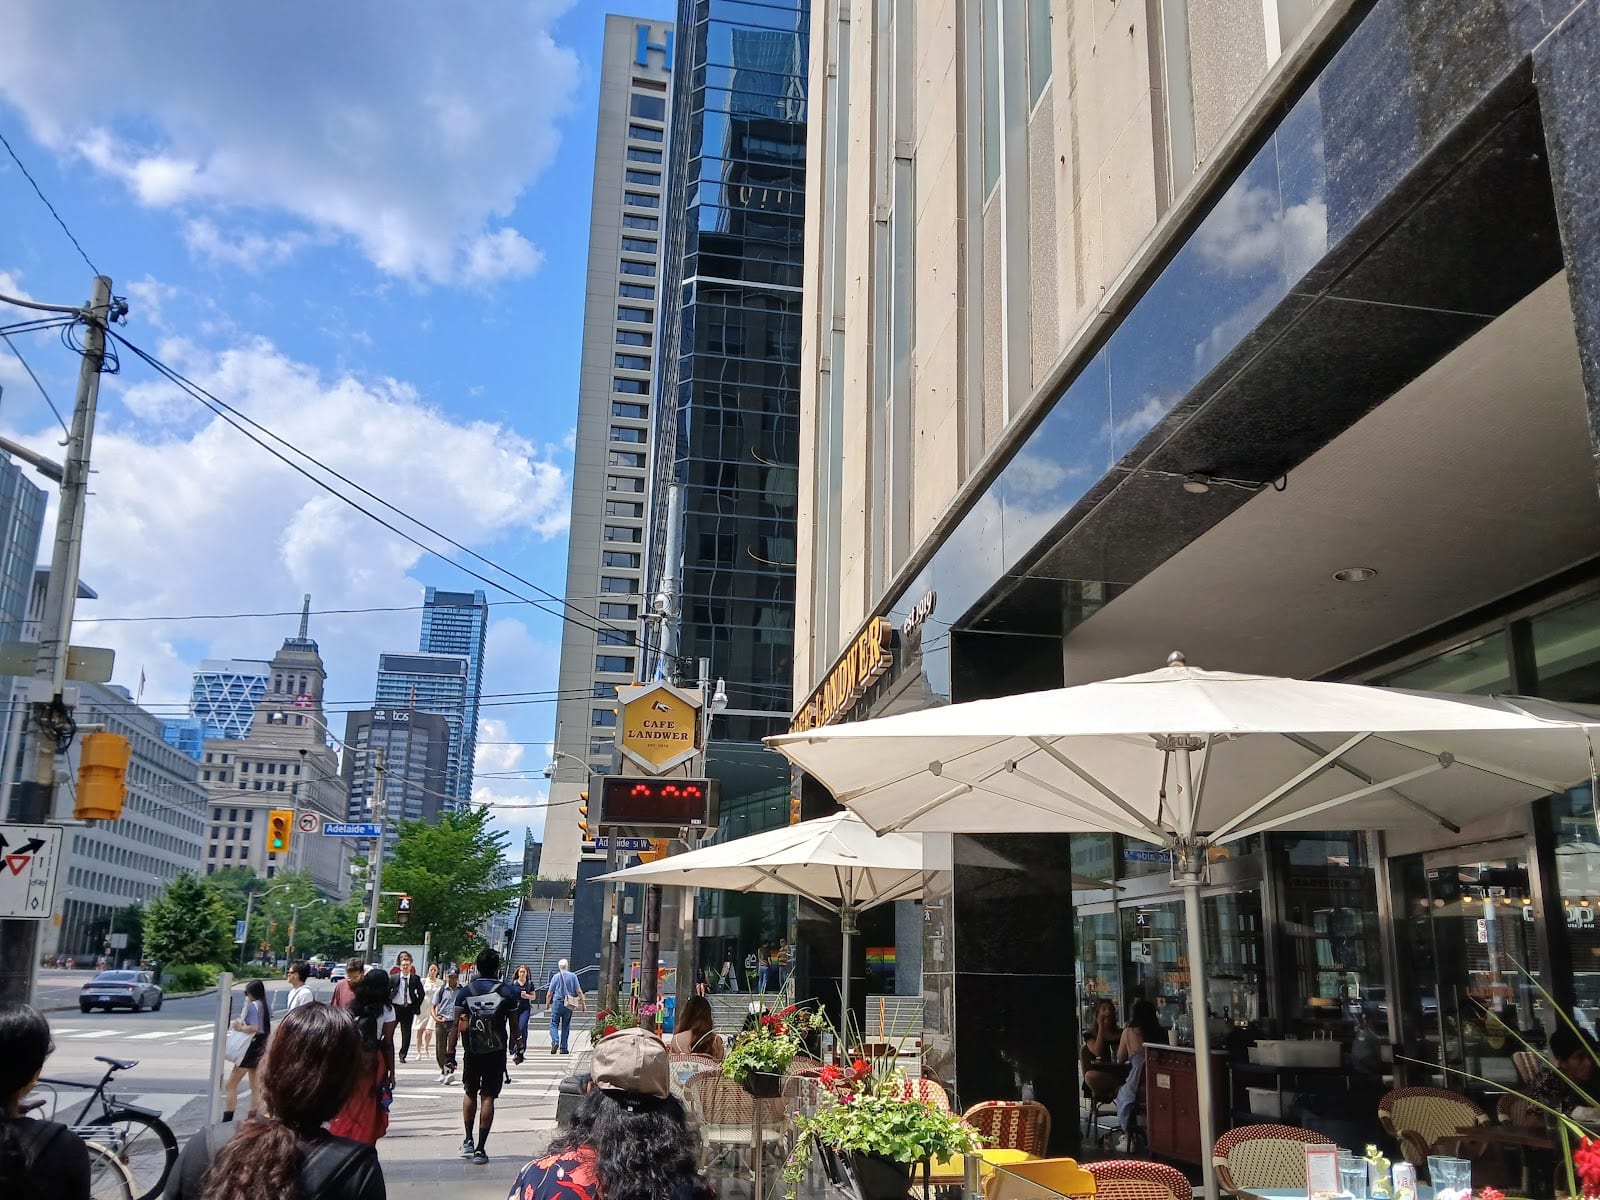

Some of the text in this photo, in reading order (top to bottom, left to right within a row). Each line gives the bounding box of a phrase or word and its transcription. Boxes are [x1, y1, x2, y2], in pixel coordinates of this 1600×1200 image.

[633, 24, 674, 71] H
[815, 616, 882, 728] LANDWER
[392, 710, 410, 722] tcs
[643, 720, 675, 729] CAFE
[628, 730, 688, 740] LANDWER
[326, 824, 365, 834] Adelaide
[373, 825, 382, 834] W
[598, 837, 630, 848] Adide
[640, 839, 648, 848] W
